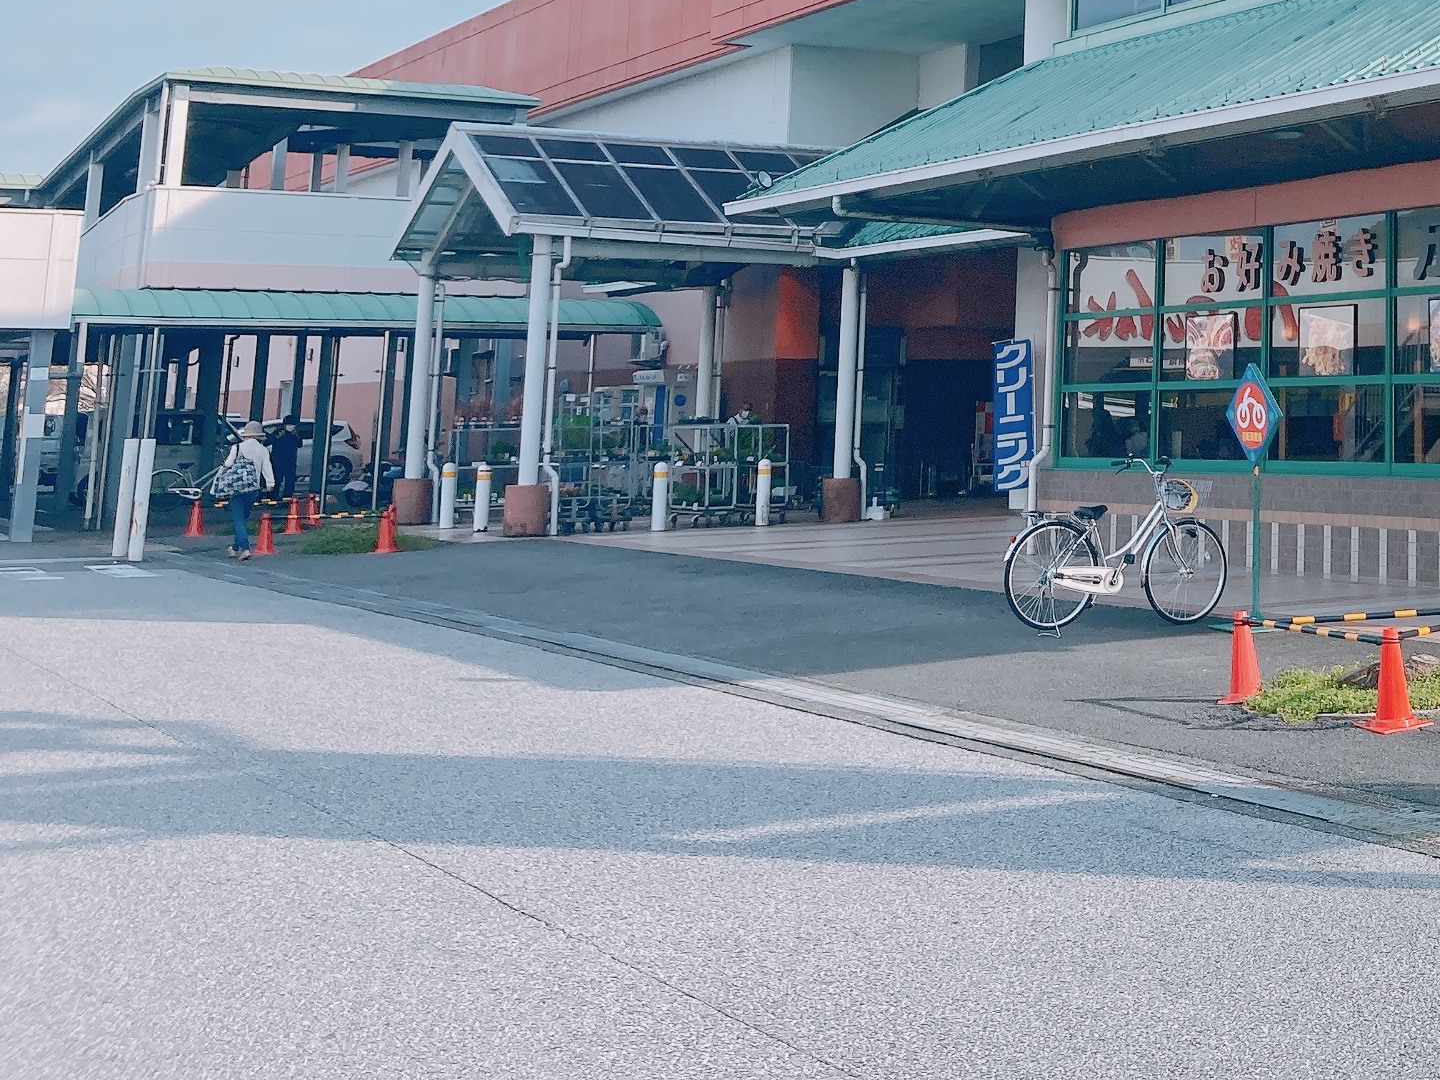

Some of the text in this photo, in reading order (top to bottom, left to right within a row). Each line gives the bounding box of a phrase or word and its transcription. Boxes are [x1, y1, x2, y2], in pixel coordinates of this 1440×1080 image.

[1201, 227, 1379, 293] お好み焼き
[997, 342, 1030, 490] クリーニング
